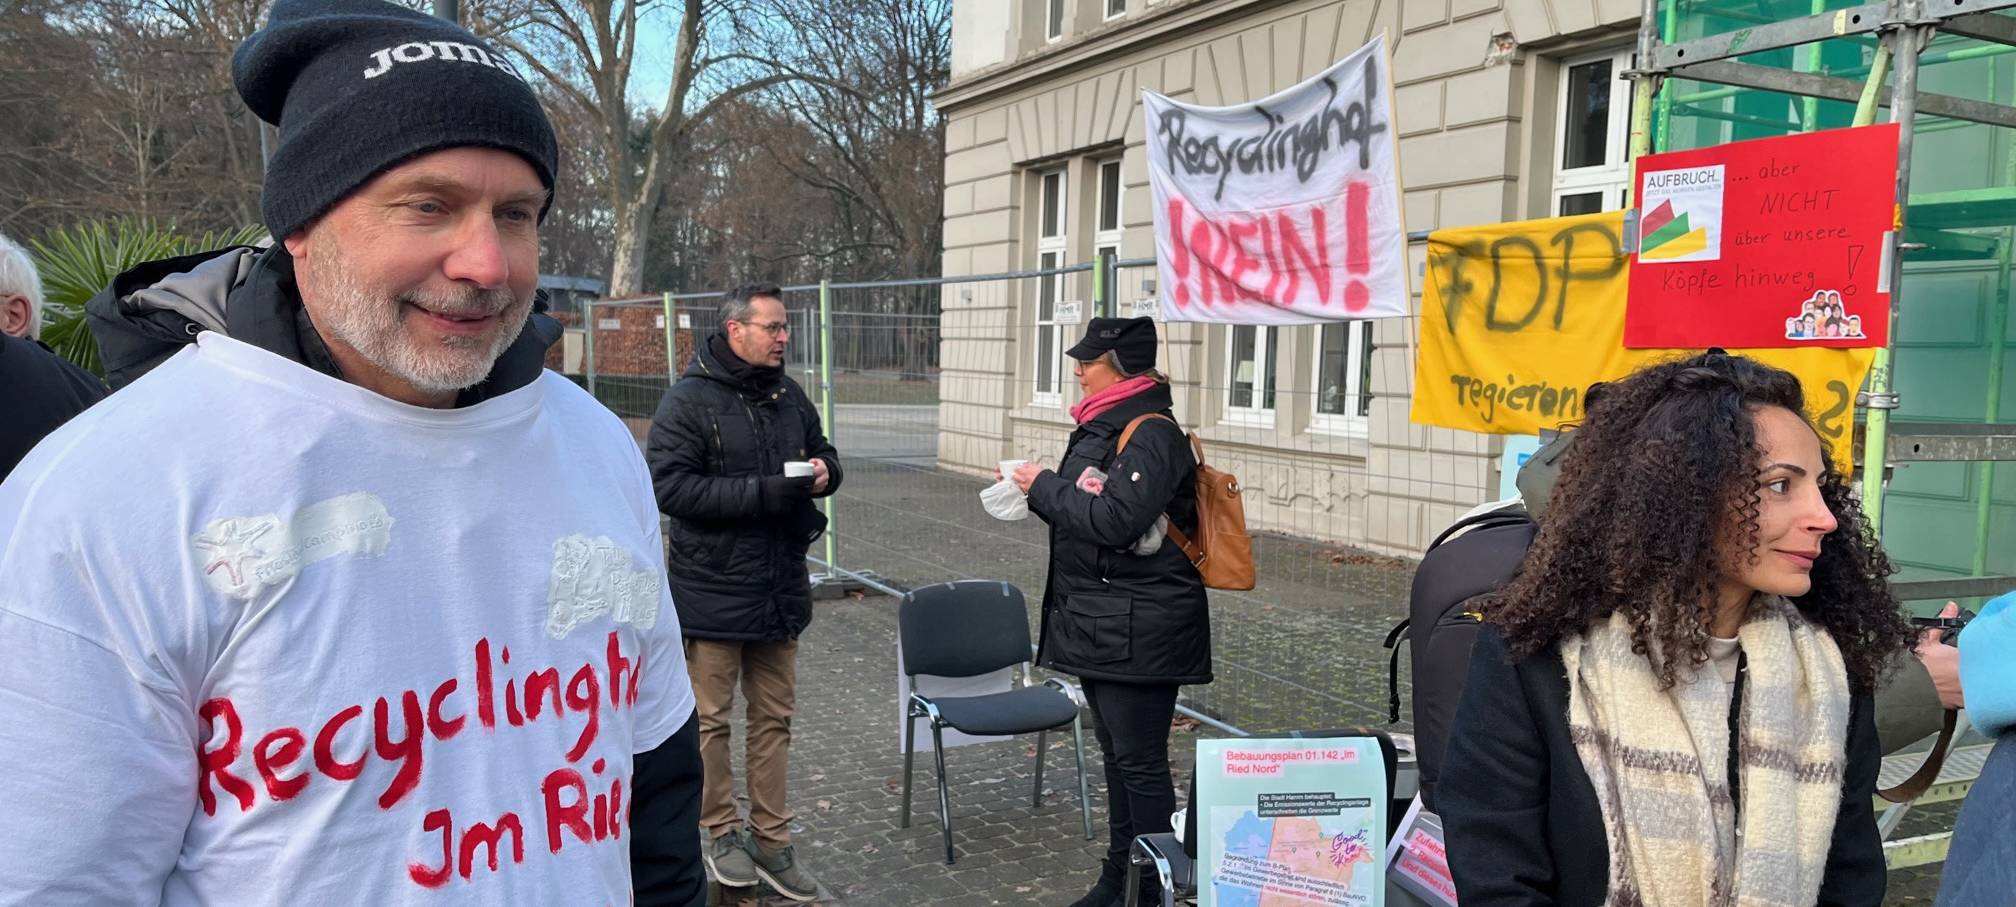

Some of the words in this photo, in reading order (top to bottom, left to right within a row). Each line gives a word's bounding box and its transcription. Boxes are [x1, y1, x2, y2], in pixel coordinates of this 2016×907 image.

[1159, 55, 1386, 201] Recyclinghof
[1759, 157, 1800, 179] aber
[1760, 189, 1840, 215] NICHT
[1735, 233, 1769, 246] über
[1783, 226, 1851, 241] unsere
[1430, 222, 1624, 336] FDP
[1663, 268, 1721, 296] Köpfe
[1735, 264, 1816, 292] hinweg
[1226, 750, 1303, 762] Bebauungsplan
[1304, 750, 1338, 760] 01.142
[1226, 763, 1250, 773] Ried
[541, 757, 632, 854] Rie
